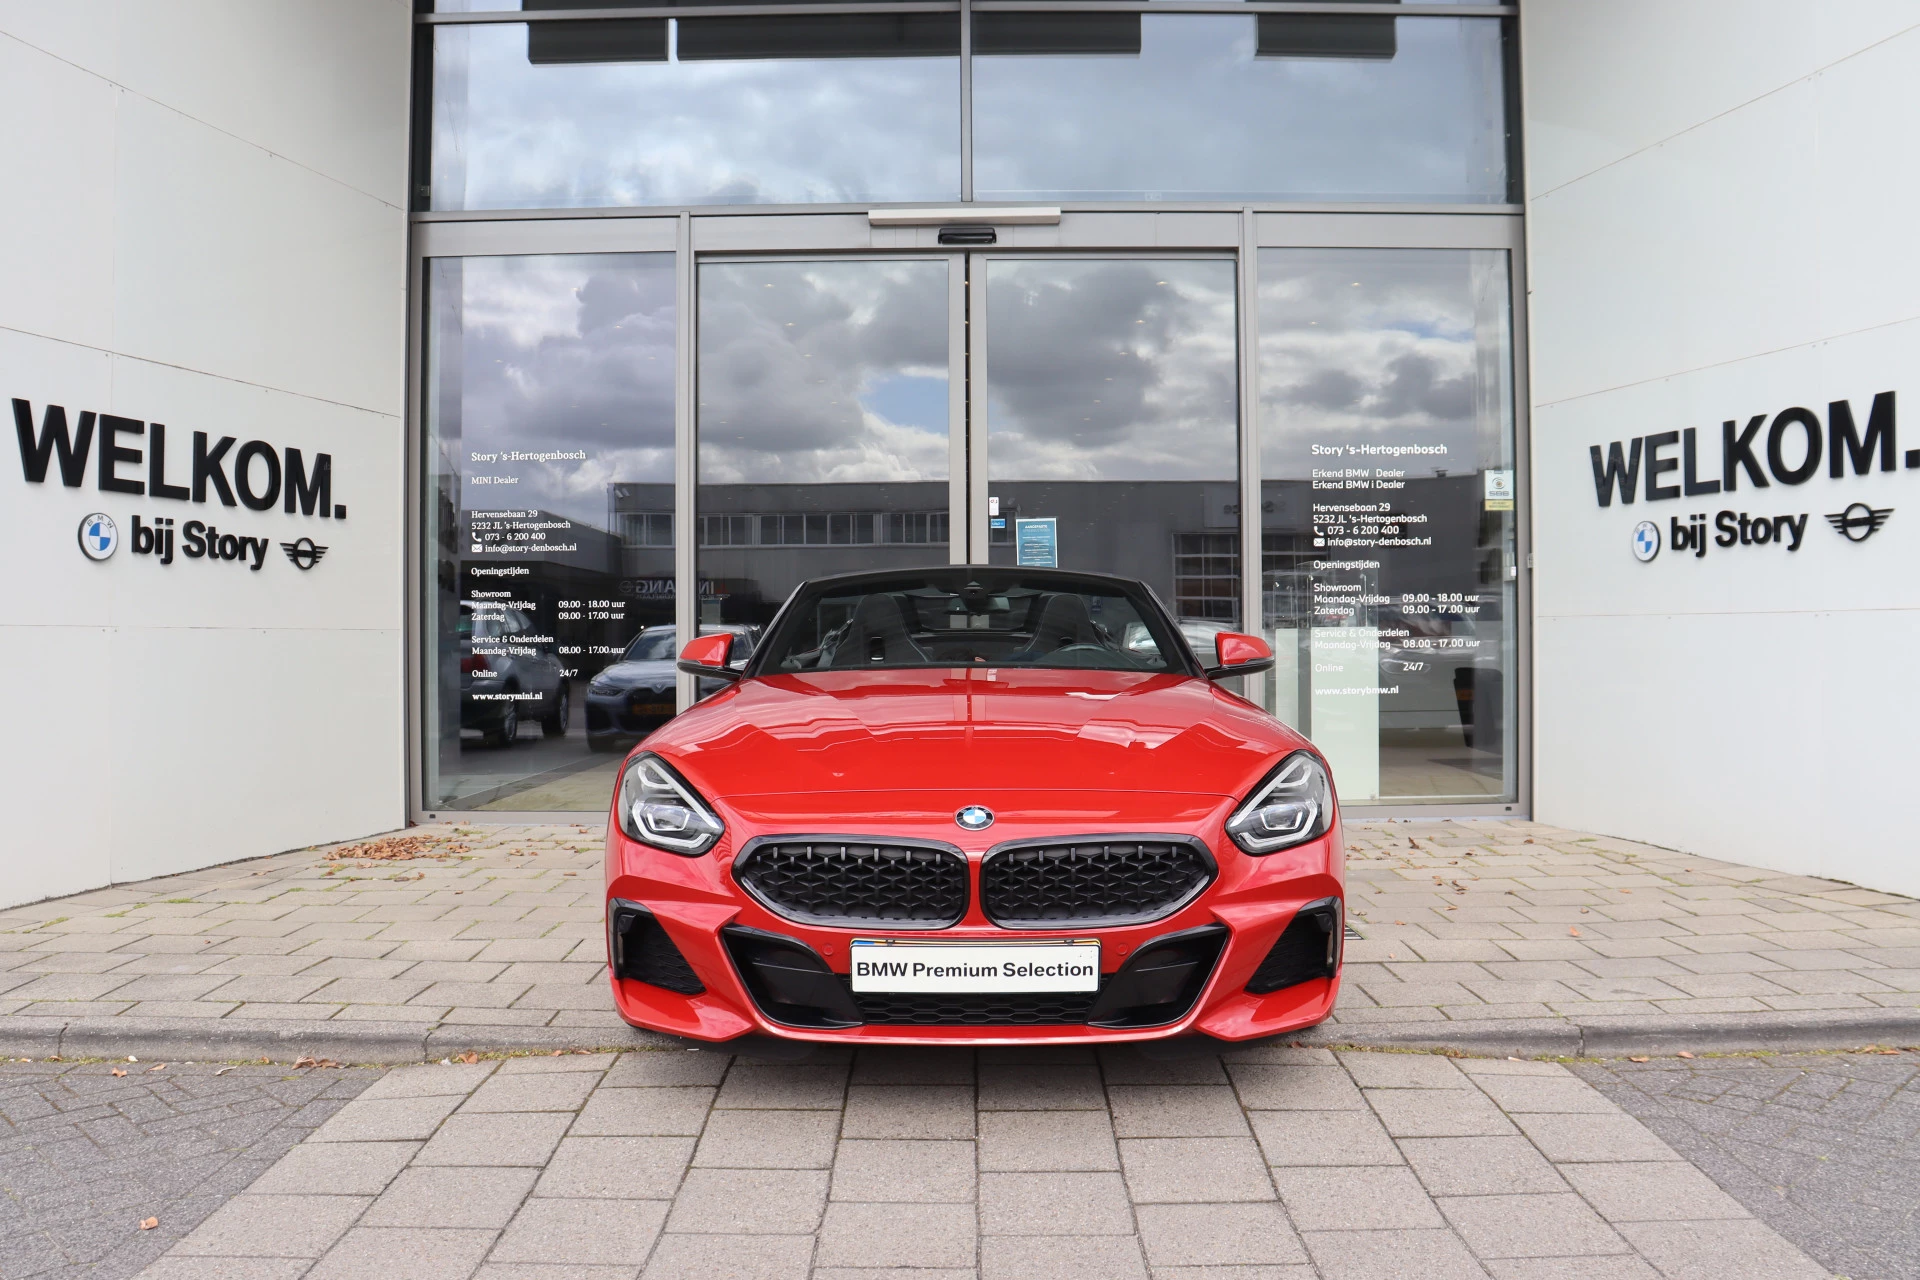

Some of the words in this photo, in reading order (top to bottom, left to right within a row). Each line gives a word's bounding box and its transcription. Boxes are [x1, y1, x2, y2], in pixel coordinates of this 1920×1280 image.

[1312, 444, 1343, 456] Story
[1590, 390, 1920, 508] WELKOM.
[11, 398, 347, 520] WELKOM.
[472, 452, 497, 463] Story
[1312, 469, 1343, 478] Erkend
[1346, 469, 1369, 477] BMW
[1376, 469, 1405, 477] Dealer
[1312, 481, 1343, 489] Erkend
[1313, 503, 1377, 512] Hervensebaan
[1314, 515, 1335, 523] 5232
[1337, 515, 1347, 523] JL
[1328, 527, 1344, 535] 073
[1353, 526, 1358, 534] 6
[1361, 526, 1378, 534] 200
[1381, 526, 1399, 534] 400
[1671, 514, 1706, 558] bij
[1715, 510, 1809, 552] Story
[131, 514, 174, 564] bij
[182, 520, 269, 570] Story
[1328, 537, 1431, 547] info@story-denbosch.nl
[485, 544, 576, 553] info@story-denbosch.nl
[1314, 560, 1380, 570] Openingstijden
[471, 567, 529, 576] Openingstijden
[1314, 583, 1361, 592] Showroom
[1314, 595, 1390, 605] Maandag-Vrijdag
[1402, 594, 1429, 602] 09.00
[1438, 594, 1462, 602] 18.00
[472, 601, 536, 610] Maandag-Vrijdag
[1314, 607, 1354, 616] Zaterdag
[1402, 606, 1430, 614] 09.00
[472, 613, 505, 622] Zaterdag
[1315, 629, 1348, 638] Service
[1359, 628, 1409, 637] Onderdelen
[1314, 640, 1391, 650] Maandag-Vrijdag
[1403, 640, 1430, 648] 08.00
[472, 646, 536, 656] Maandag-Vrijdag
[1315, 664, 1343, 672] Online
[1403, 662, 1423, 671] 24/7
[1316, 686, 1399, 695] www.storybmw.nl
[473, 692, 542, 701] www.storymini.nl
[856, 962, 908, 977] BMW
[912, 962, 998, 977] Premium
[1003, 962, 1094, 977] Selection
